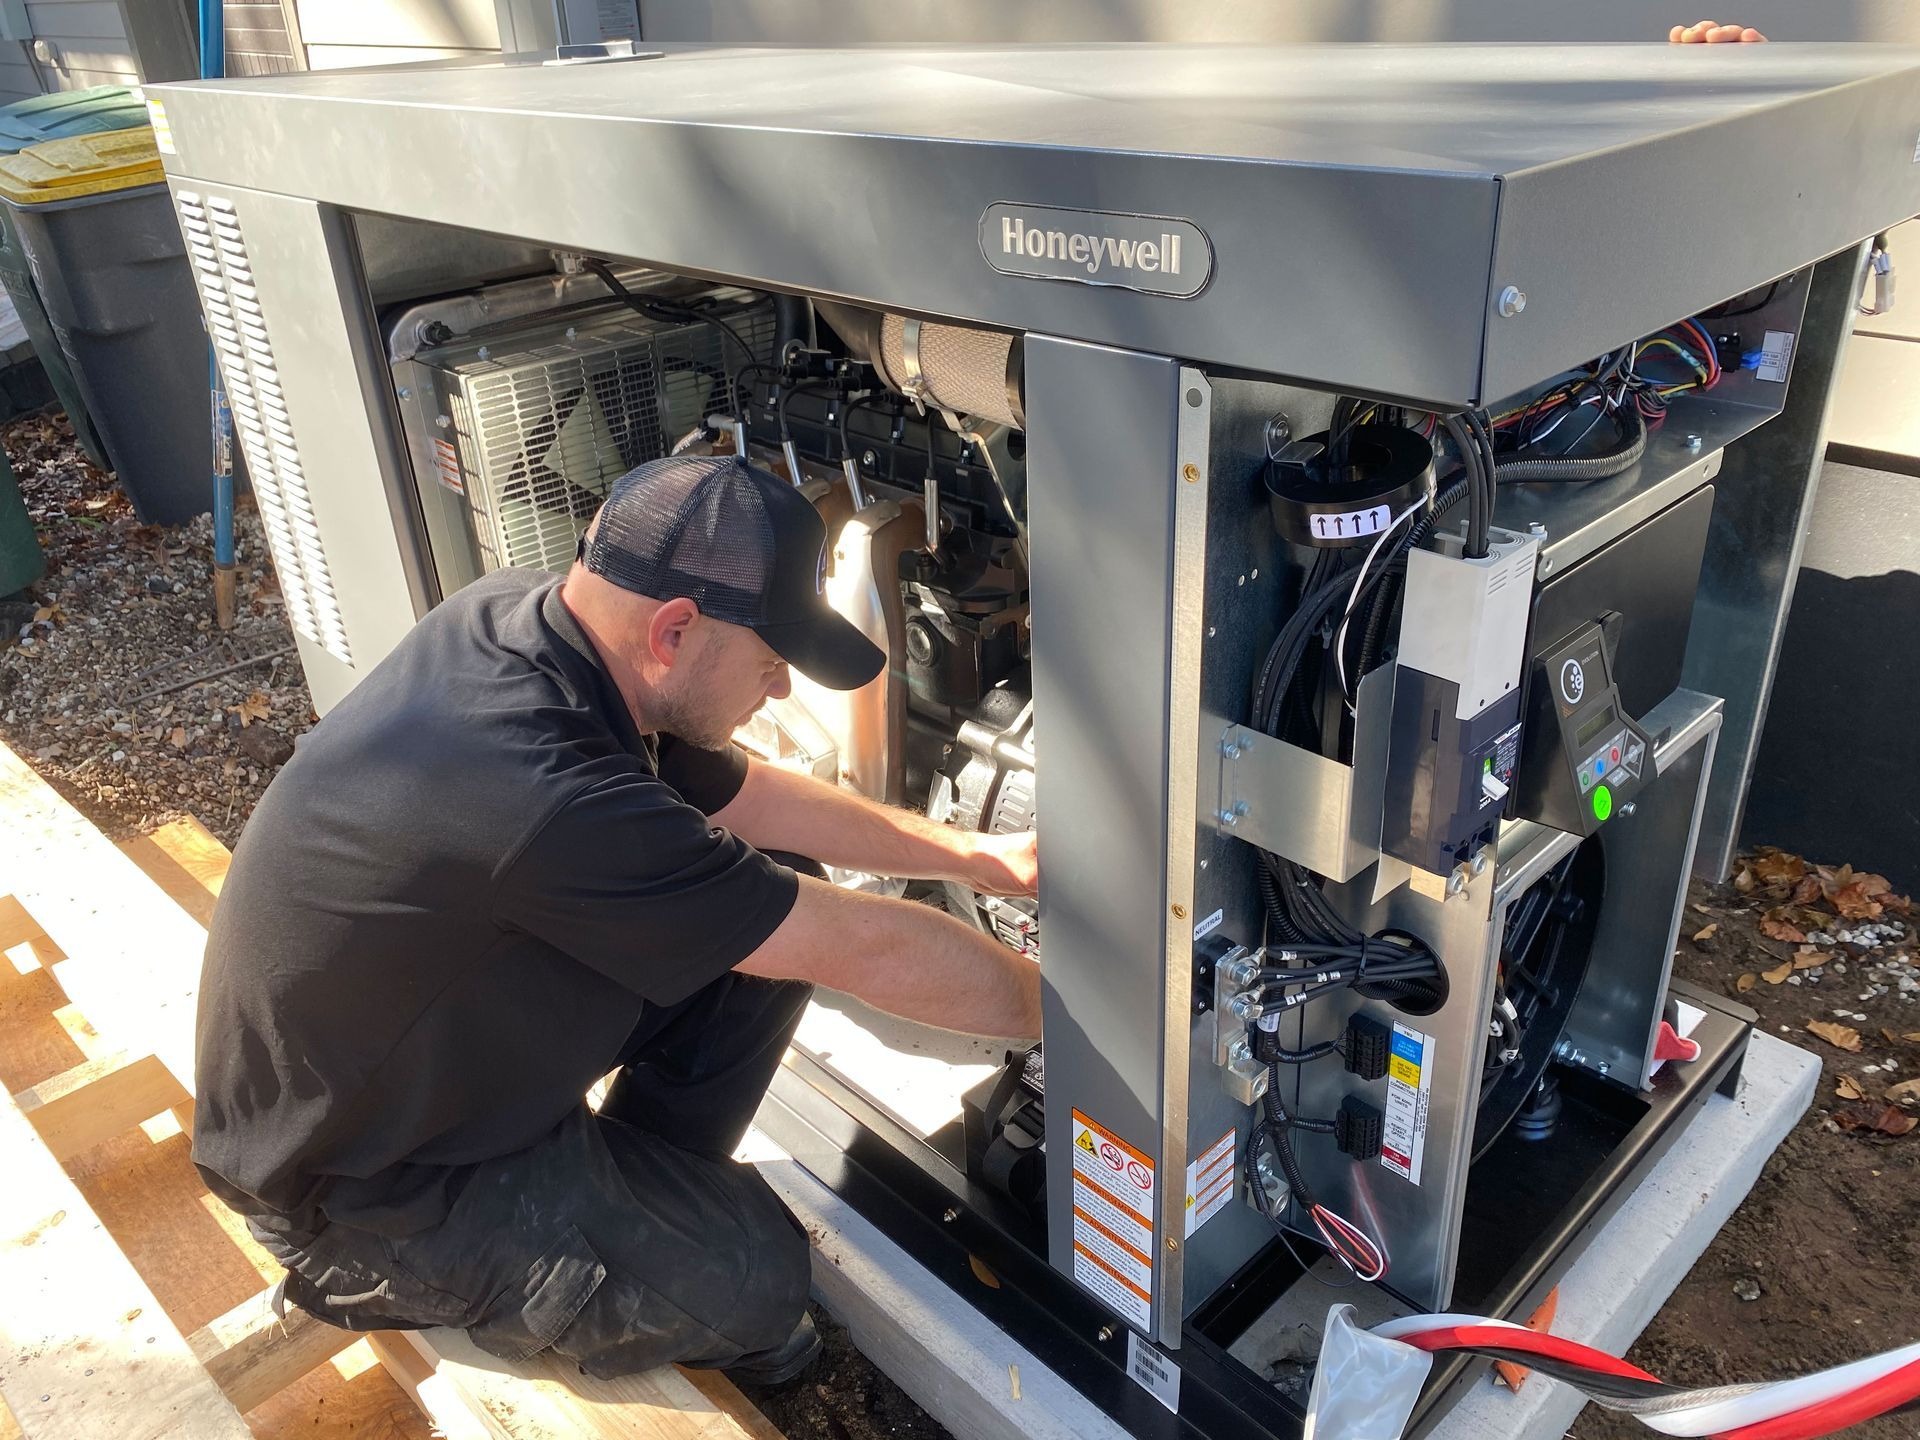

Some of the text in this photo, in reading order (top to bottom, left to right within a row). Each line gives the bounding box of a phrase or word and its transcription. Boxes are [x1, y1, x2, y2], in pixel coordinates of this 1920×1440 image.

[1002, 216, 1181, 274] Honeywell
[1195, 914, 1221, 937] NEUTRAL
[1098, 1128, 1131, 1154] WARNING
[1085, 1180, 1136, 1219] AVERTISSEMENT
[1089, 1219, 1134, 1254] ADVERTENCIA
